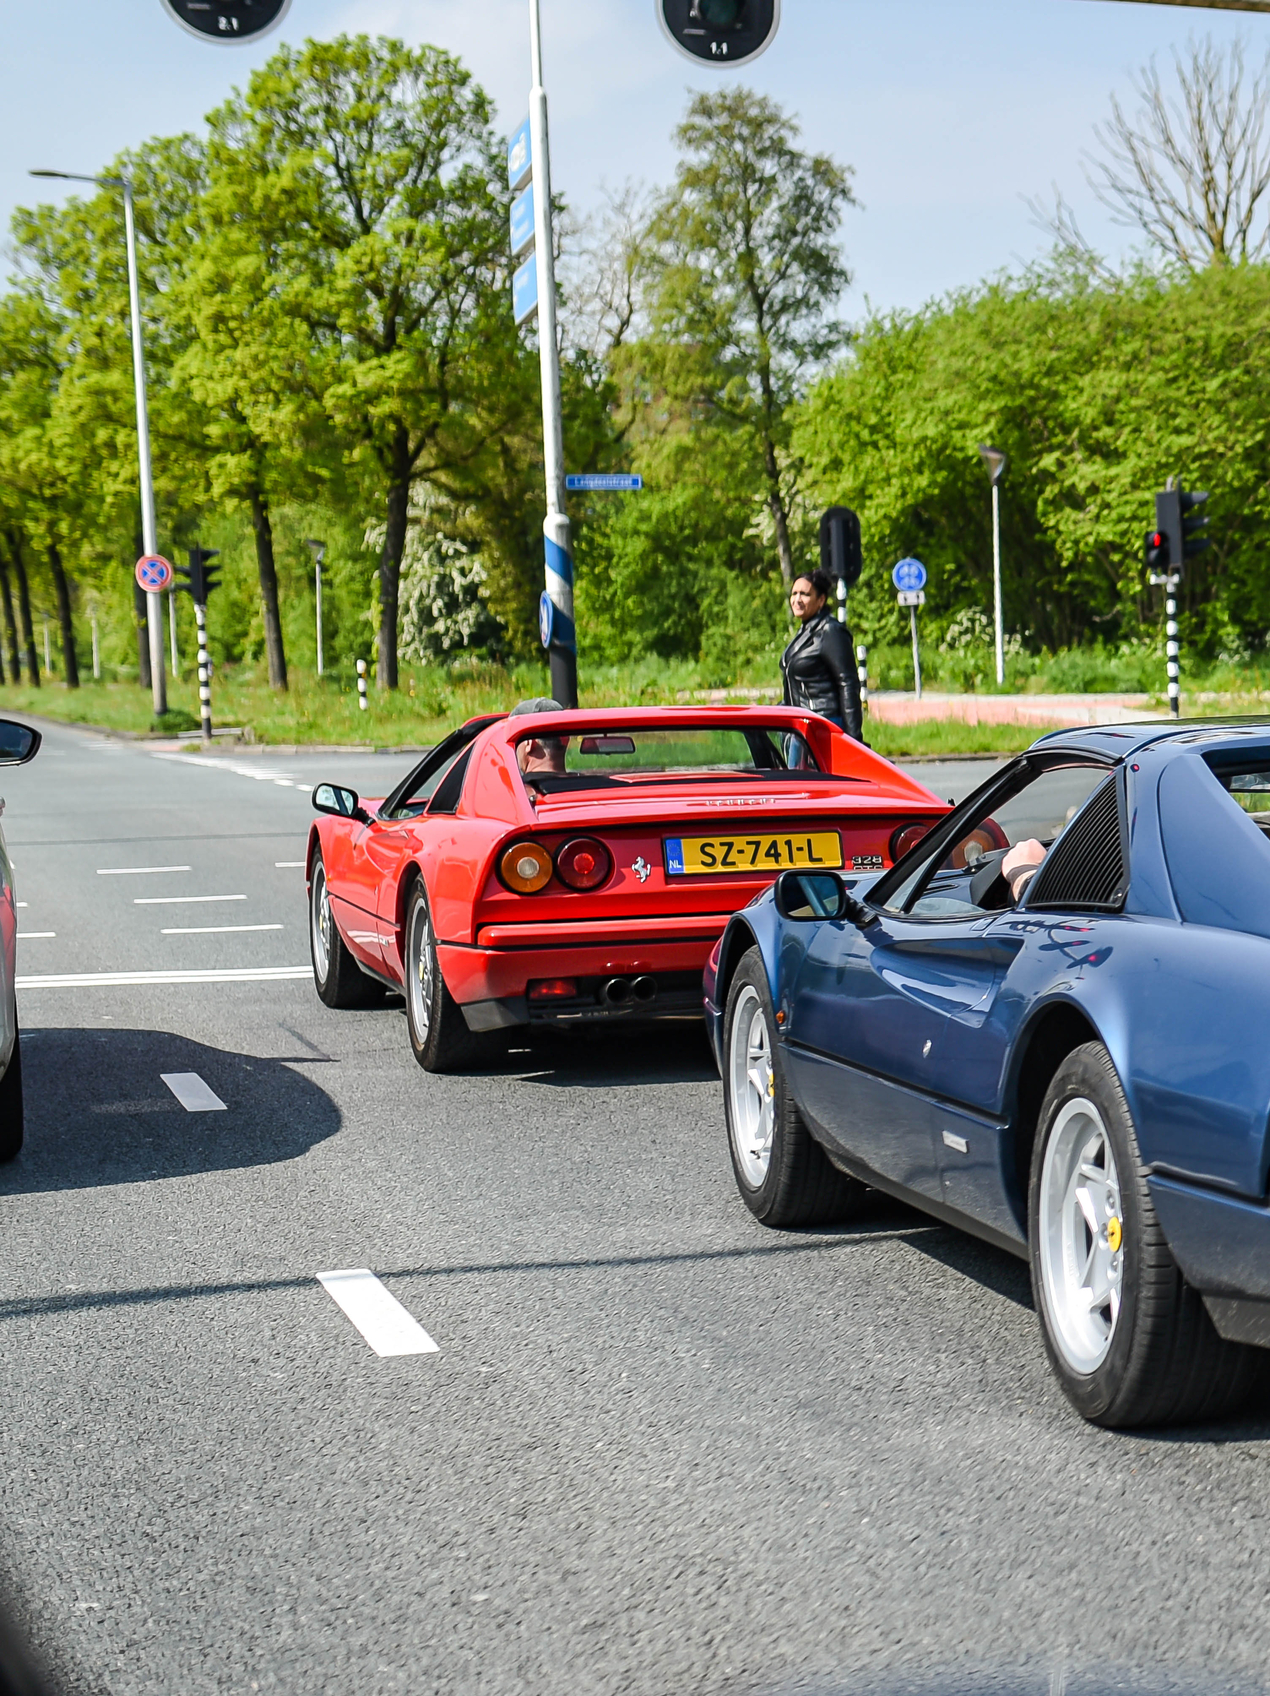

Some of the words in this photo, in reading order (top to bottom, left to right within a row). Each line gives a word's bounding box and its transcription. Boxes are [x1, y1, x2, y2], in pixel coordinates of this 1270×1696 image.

[709, 41, 728, 55] 1.1
[699, 838, 824, 868] SZ-741-L
[668, 859, 682, 869] NL
[852, 855, 882, 864] 328
